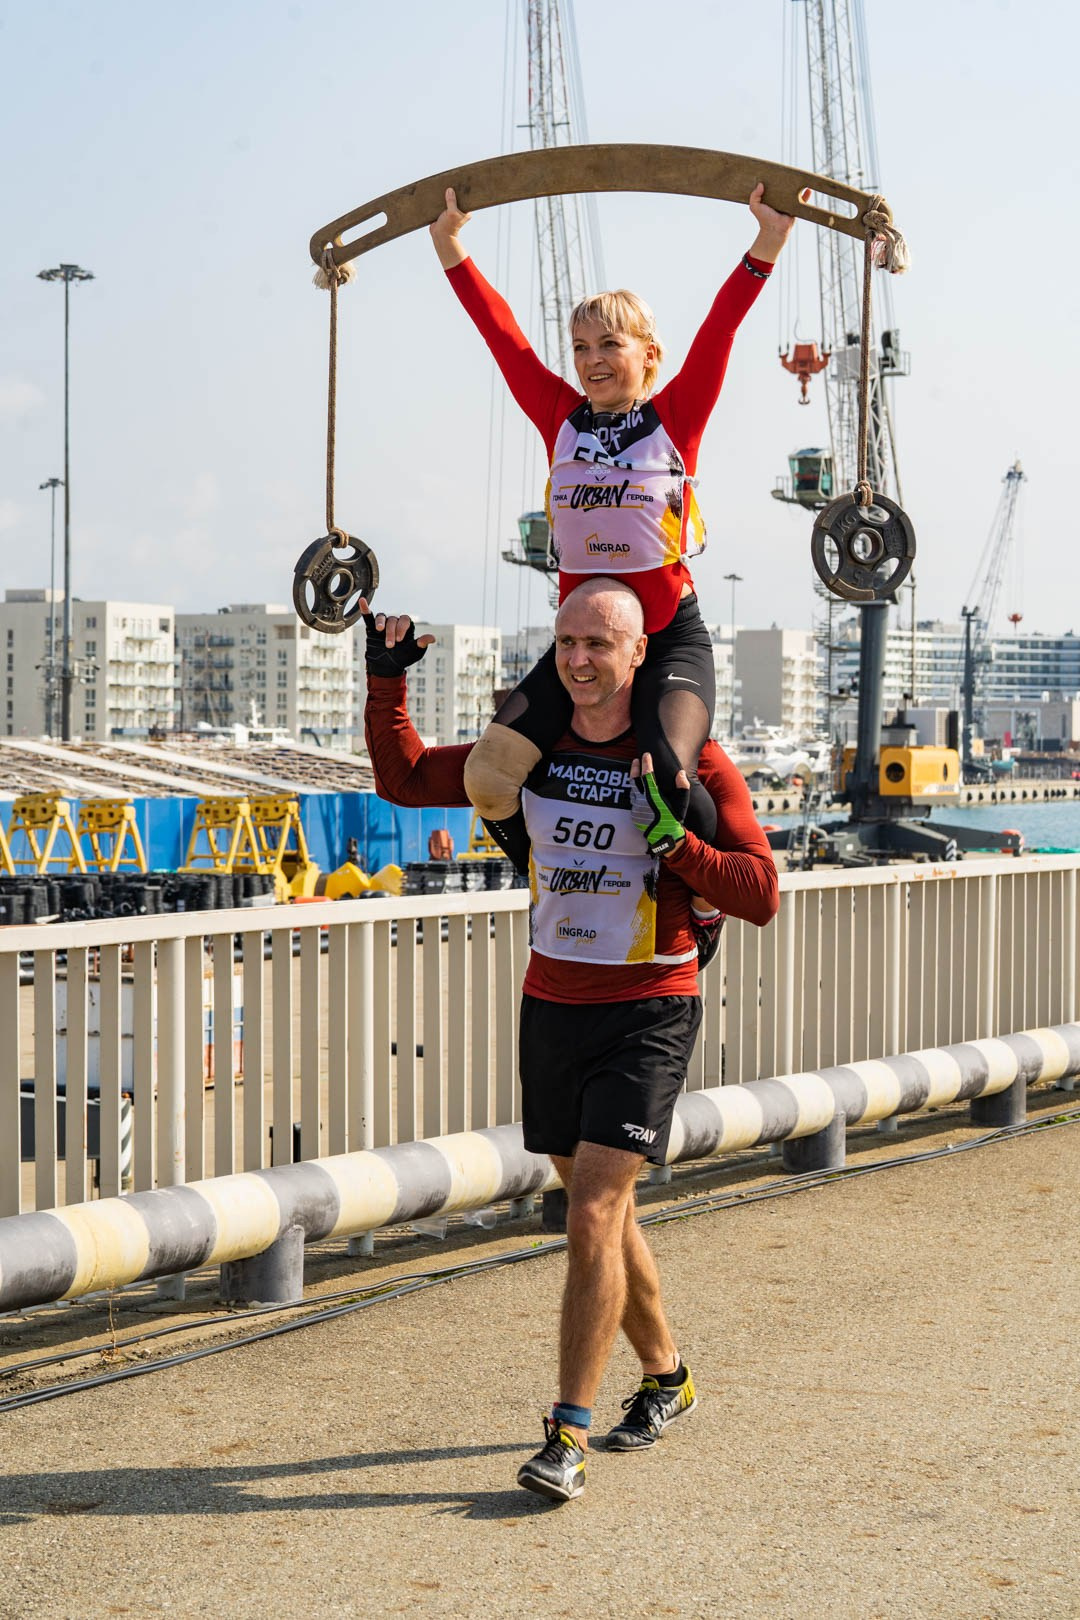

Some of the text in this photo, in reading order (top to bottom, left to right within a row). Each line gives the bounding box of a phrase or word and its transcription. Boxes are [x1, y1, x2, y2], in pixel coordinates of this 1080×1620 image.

[570, 480, 630, 511] URBAN
[626, 493, 654, 502] ГЕРОЕВ
[589, 543, 631, 553] INGRAD
[548, 762, 632, 788] МАССОВ
[566, 783, 625, 804] СТАРТ
[552, 816, 616, 850] 560
[550, 865, 607, 896] URBAN
[603, 880, 632, 888] ГЕРОЕВ
[559, 926, 597, 939] INGRAD
